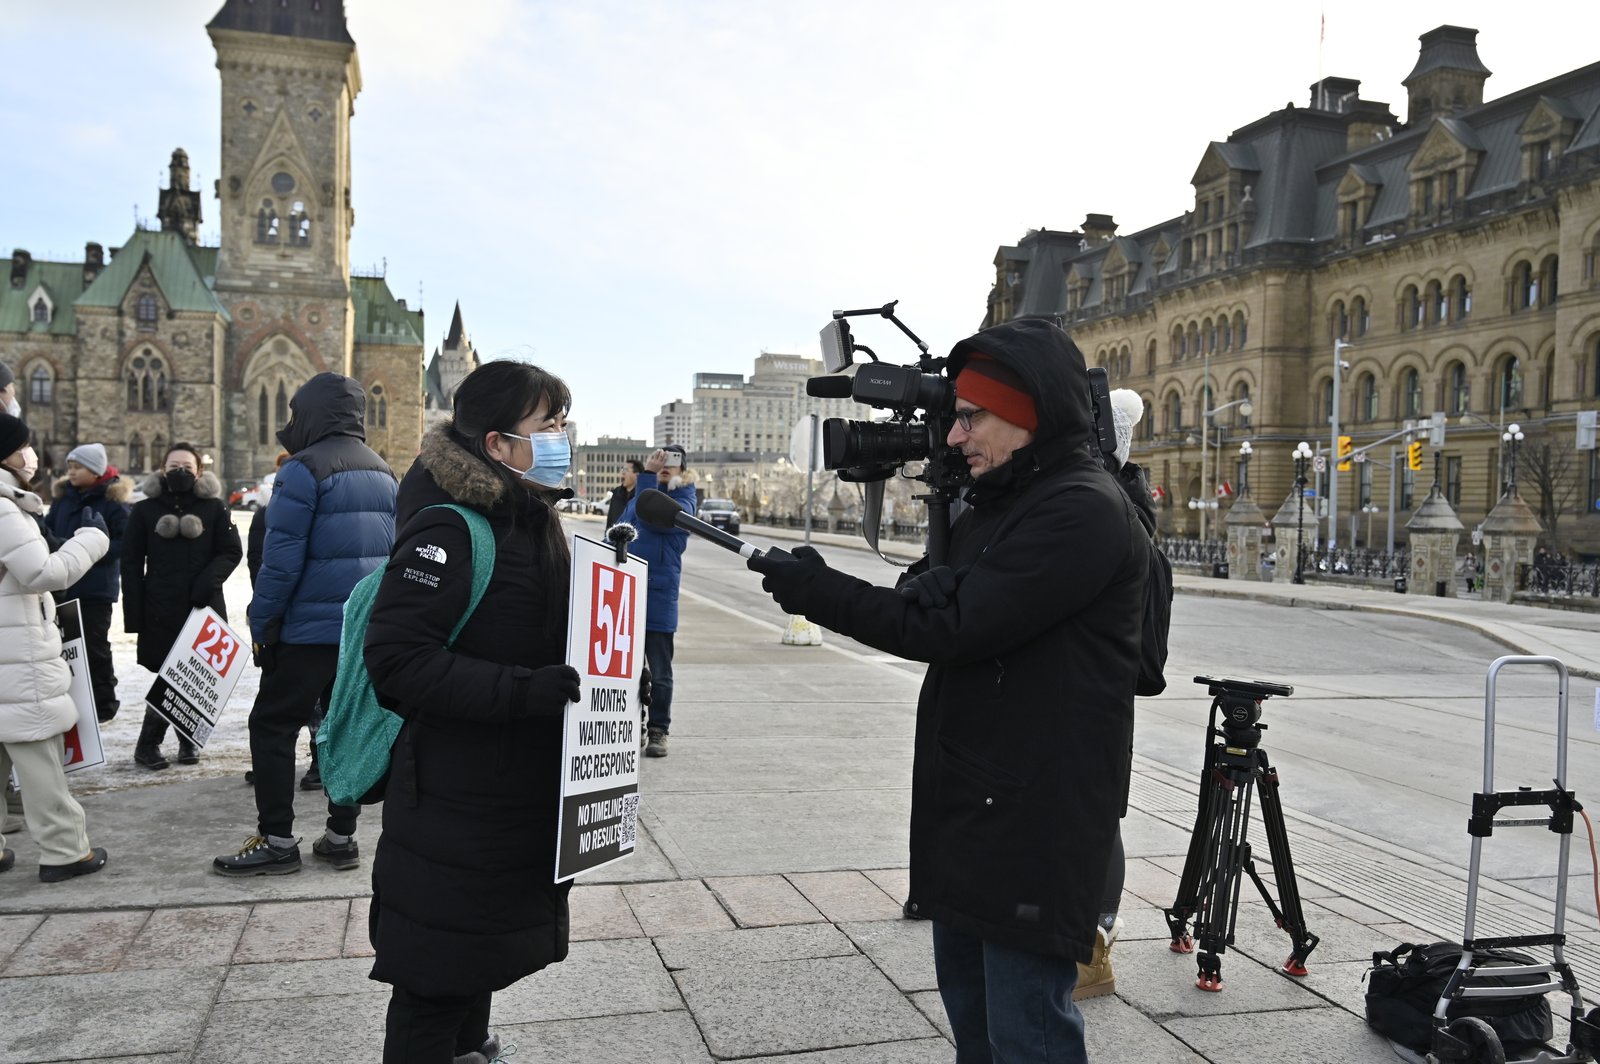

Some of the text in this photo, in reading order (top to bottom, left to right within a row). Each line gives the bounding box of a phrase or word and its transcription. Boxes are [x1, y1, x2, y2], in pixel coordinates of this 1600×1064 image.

[415, 546, 438, 558] NORTH
[419, 551, 436, 562] FACE
[427, 544, 439, 552] THE
[403, 572, 438, 588] EXPLORING
[405, 567, 441, 582] NEVER STOP
[594, 567, 631, 675] 54
[195, 622, 235, 672] 23
[176, 659, 219, 704] WAITING FOR
[188, 656, 218, 687] MONTHS
[164, 687, 175, 701] NO
[165, 666, 218, 718] IRCC RESPONSE
[590, 687, 627, 713] MONTHS
[161, 698, 197, 733] NO RESULTS
[579, 720, 633, 746] WAITING FOR
[570, 750, 636, 782] IRCC RESPONSE
[577, 804, 590, 827] NO
[579, 822, 622, 854] NO RESULTS
